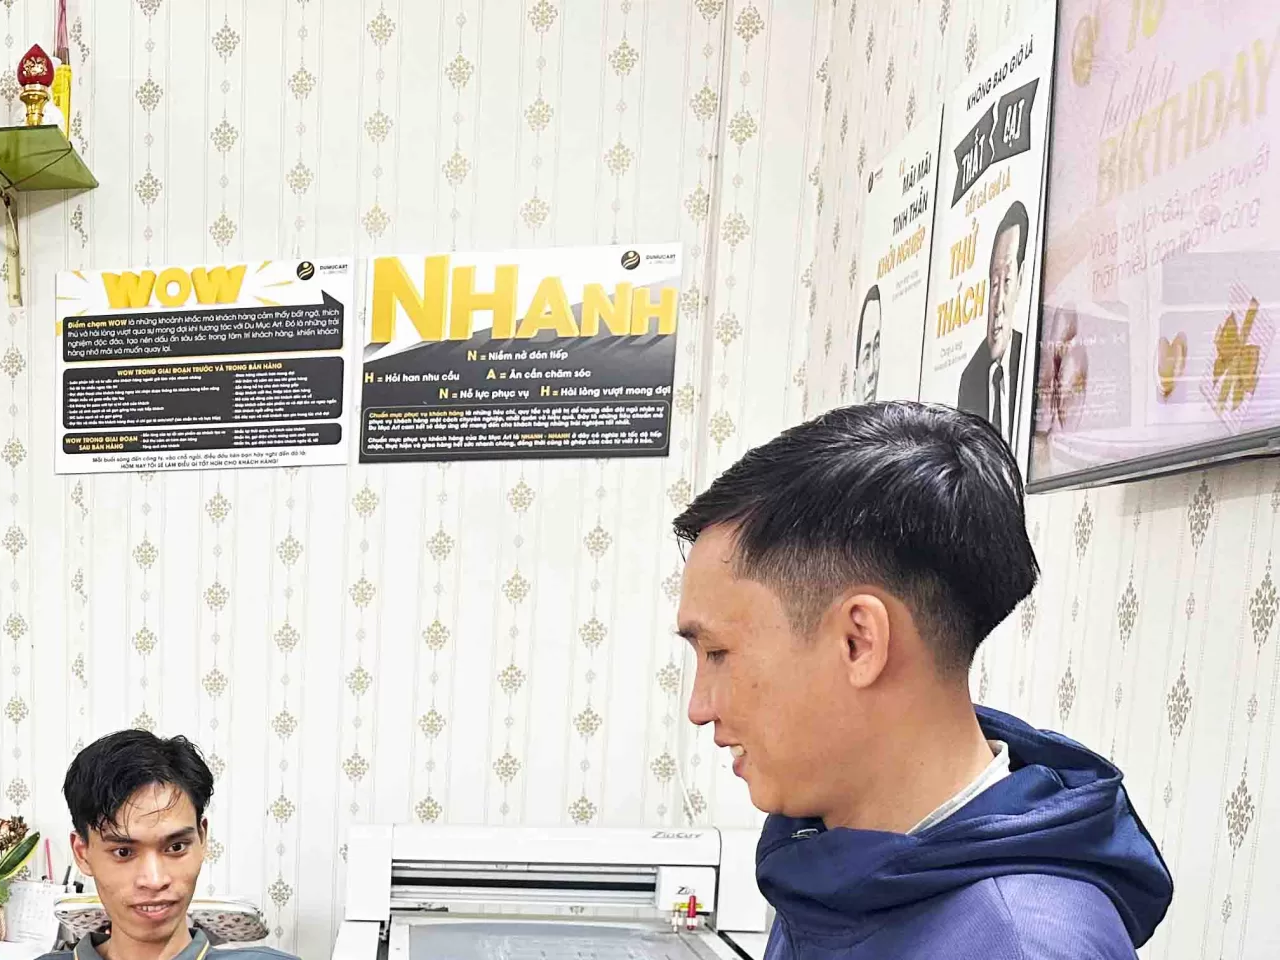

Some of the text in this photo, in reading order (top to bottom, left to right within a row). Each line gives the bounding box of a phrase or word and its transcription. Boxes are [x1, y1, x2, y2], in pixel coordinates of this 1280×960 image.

[966, 79, 992, 111] KHÔNG
[993, 62, 1008, 90] BAO
[1009, 45, 1024, 74] GIỜ
[1097, 25, 1280, 207] BIRTHDAY
[962, 128, 986, 190] THẤT
[892, 185, 928, 236] TINH THẦN
[950, 217, 979, 280] THỬ
[101, 265, 247, 308] WOW
[370, 255, 678, 343] NHANH
[936, 282, 986, 338] THÁCH
[255, 321, 271, 329] Mục
[365, 372, 374, 382] H
[384, 372, 401, 382] Hỏi
[402, 373, 421, 382] han
[421, 373, 440, 381] nhu
[441, 370, 460, 381] cầu
[467, 350, 477, 361] N
[488, 349, 512, 360] Niềm
[514, 350, 527, 360] nở
[529, 350, 547, 359] đón
[549, 348, 568, 360] tiếp
[486, 368, 496, 379] A
[509, 368, 522, 379] Ân
[524, 367, 543, 379] cần
[544, 369, 572, 378] chăm
[574, 368, 591, 377] sóc
[439, 388, 448, 399] N
[460, 388, 473, 398] Nỗ
[475, 389, 489, 400] lực
[491, 389, 515, 399] phục
[518, 390, 529, 399] vụ
[540, 386, 550, 396] H
[560, 387, 576, 396] Hài
[579, 387, 600, 397] lòng
[603, 386, 623, 397] vượt
[626, 388, 652, 396] mong
[655, 386, 671, 395] đợi
